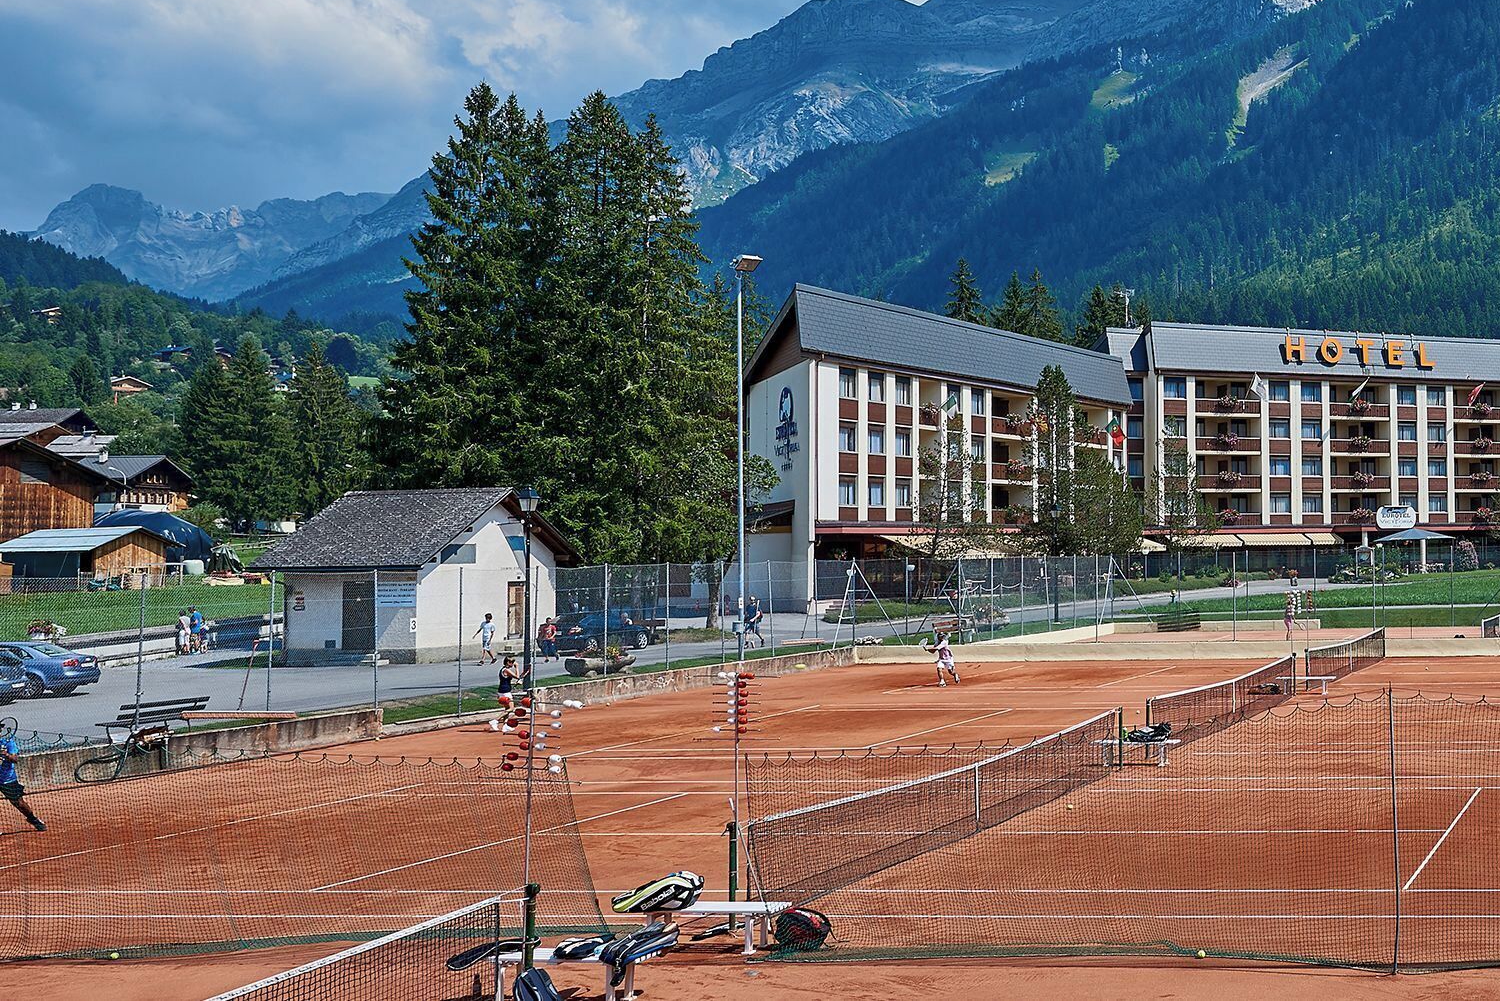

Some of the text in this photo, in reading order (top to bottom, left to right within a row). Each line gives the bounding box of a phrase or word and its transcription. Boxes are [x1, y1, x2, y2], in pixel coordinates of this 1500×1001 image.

[1285, 336, 1437, 367] HOTEL
[411, 620, 417, 630] 3
[640, 884, 676, 911] Babolat
